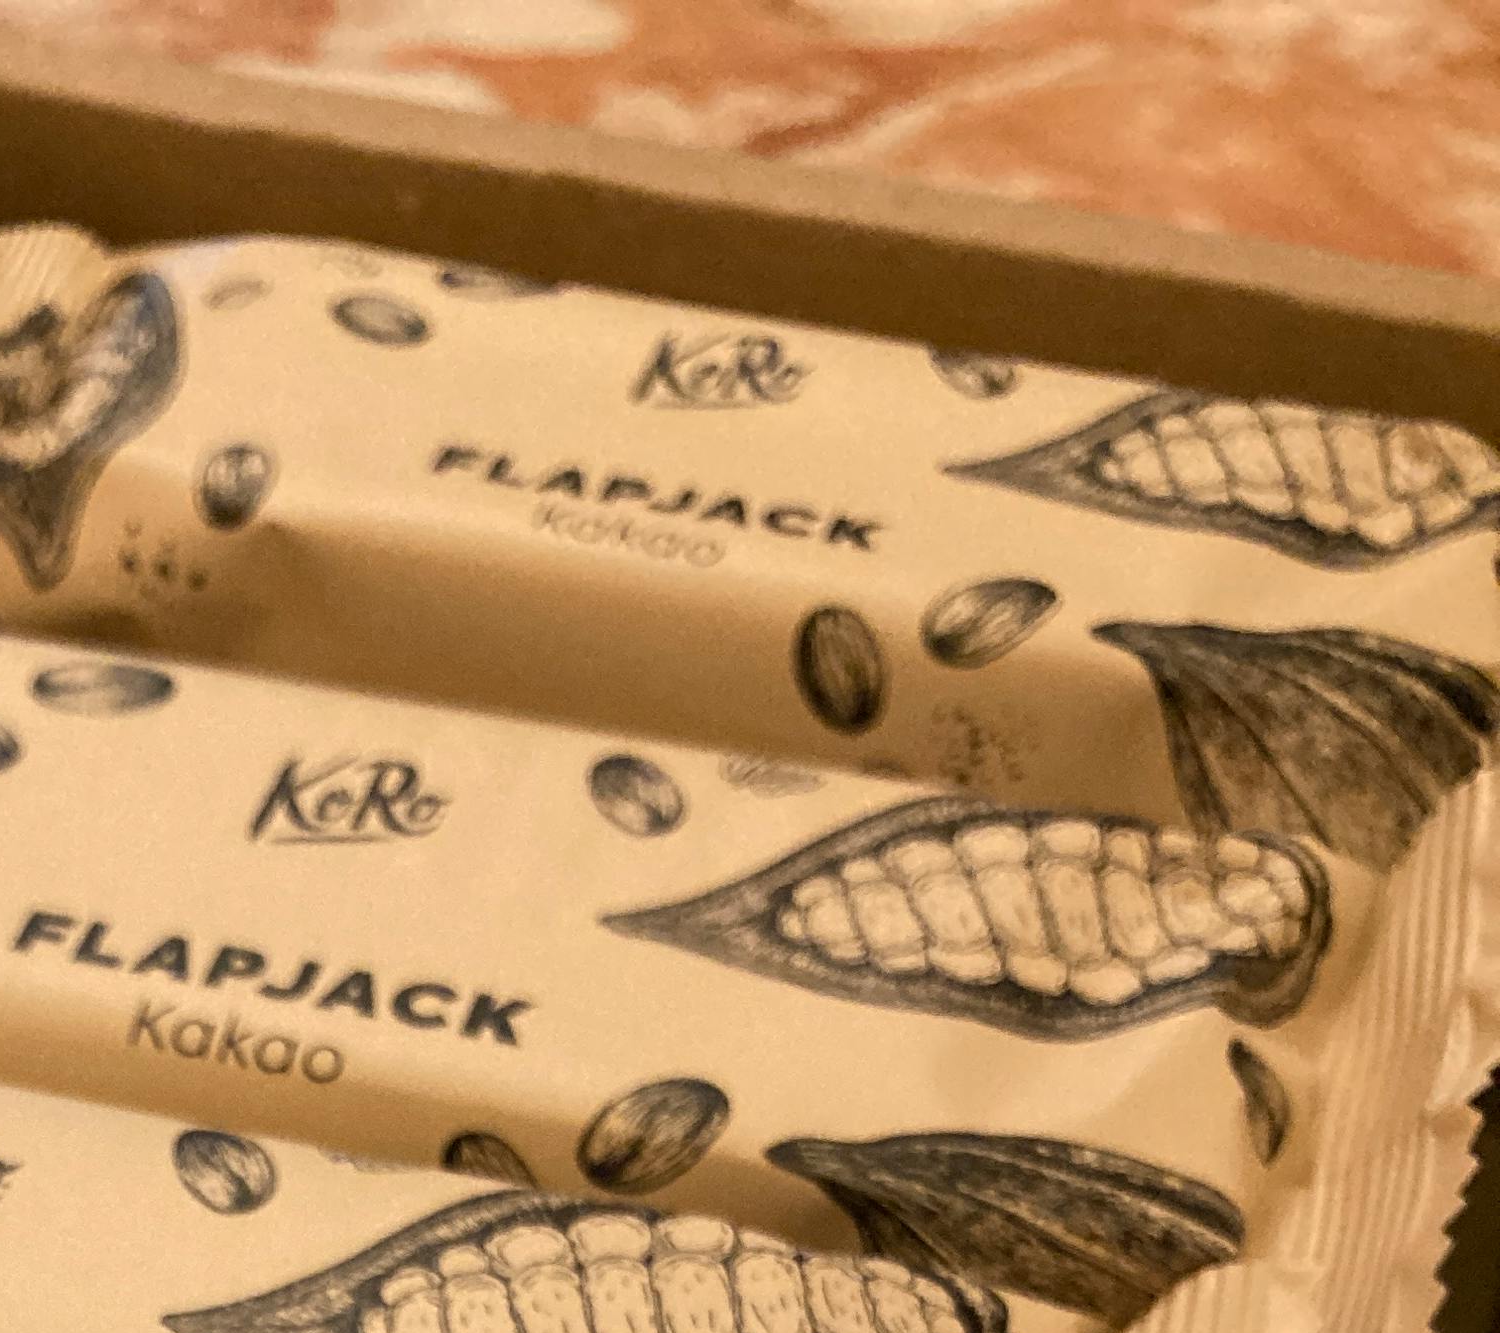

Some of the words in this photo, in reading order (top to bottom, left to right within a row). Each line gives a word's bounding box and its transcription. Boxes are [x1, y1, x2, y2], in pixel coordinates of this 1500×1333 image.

[429, 442, 887, 554] FLAPJACK
[11, 908, 534, 1046] FLAPJACK
[128, 998, 345, 1084] Kakao
